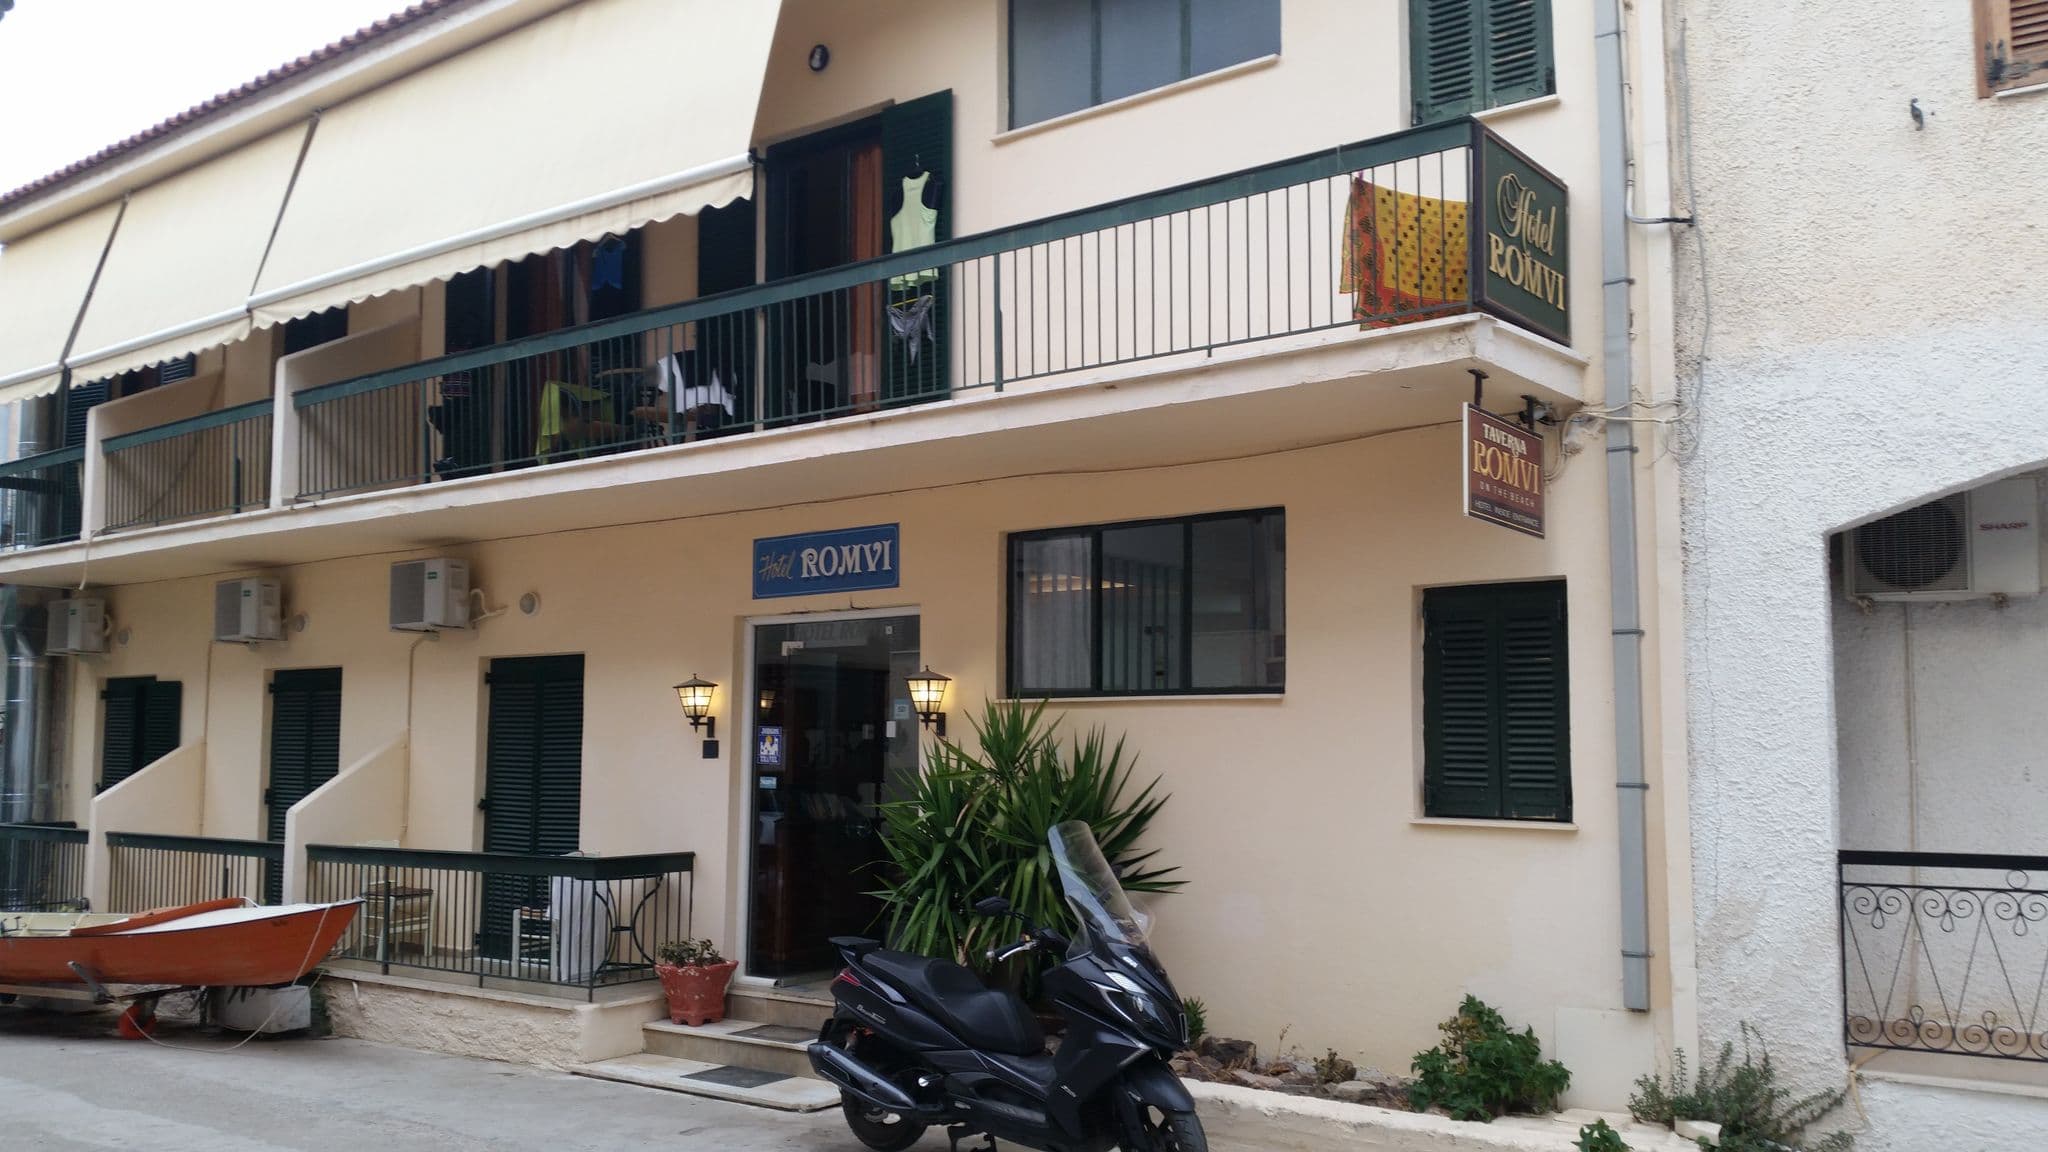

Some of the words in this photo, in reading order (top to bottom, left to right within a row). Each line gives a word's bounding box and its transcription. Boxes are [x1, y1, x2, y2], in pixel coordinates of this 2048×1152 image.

[1497, 173, 1556, 256] Hotel
[1488, 232, 1565, 311] ROMVI
[1482, 423, 1527, 457] TAVERNA
[1473, 439, 1540, 495] ROMVI
[1479, 481, 1490, 492] ON
[1493, 485, 1508, 499] THE
[1510, 490, 1535, 508] BEACH
[759, 550, 796, 581] Hotel
[800, 540, 891, 577] ROMVI
